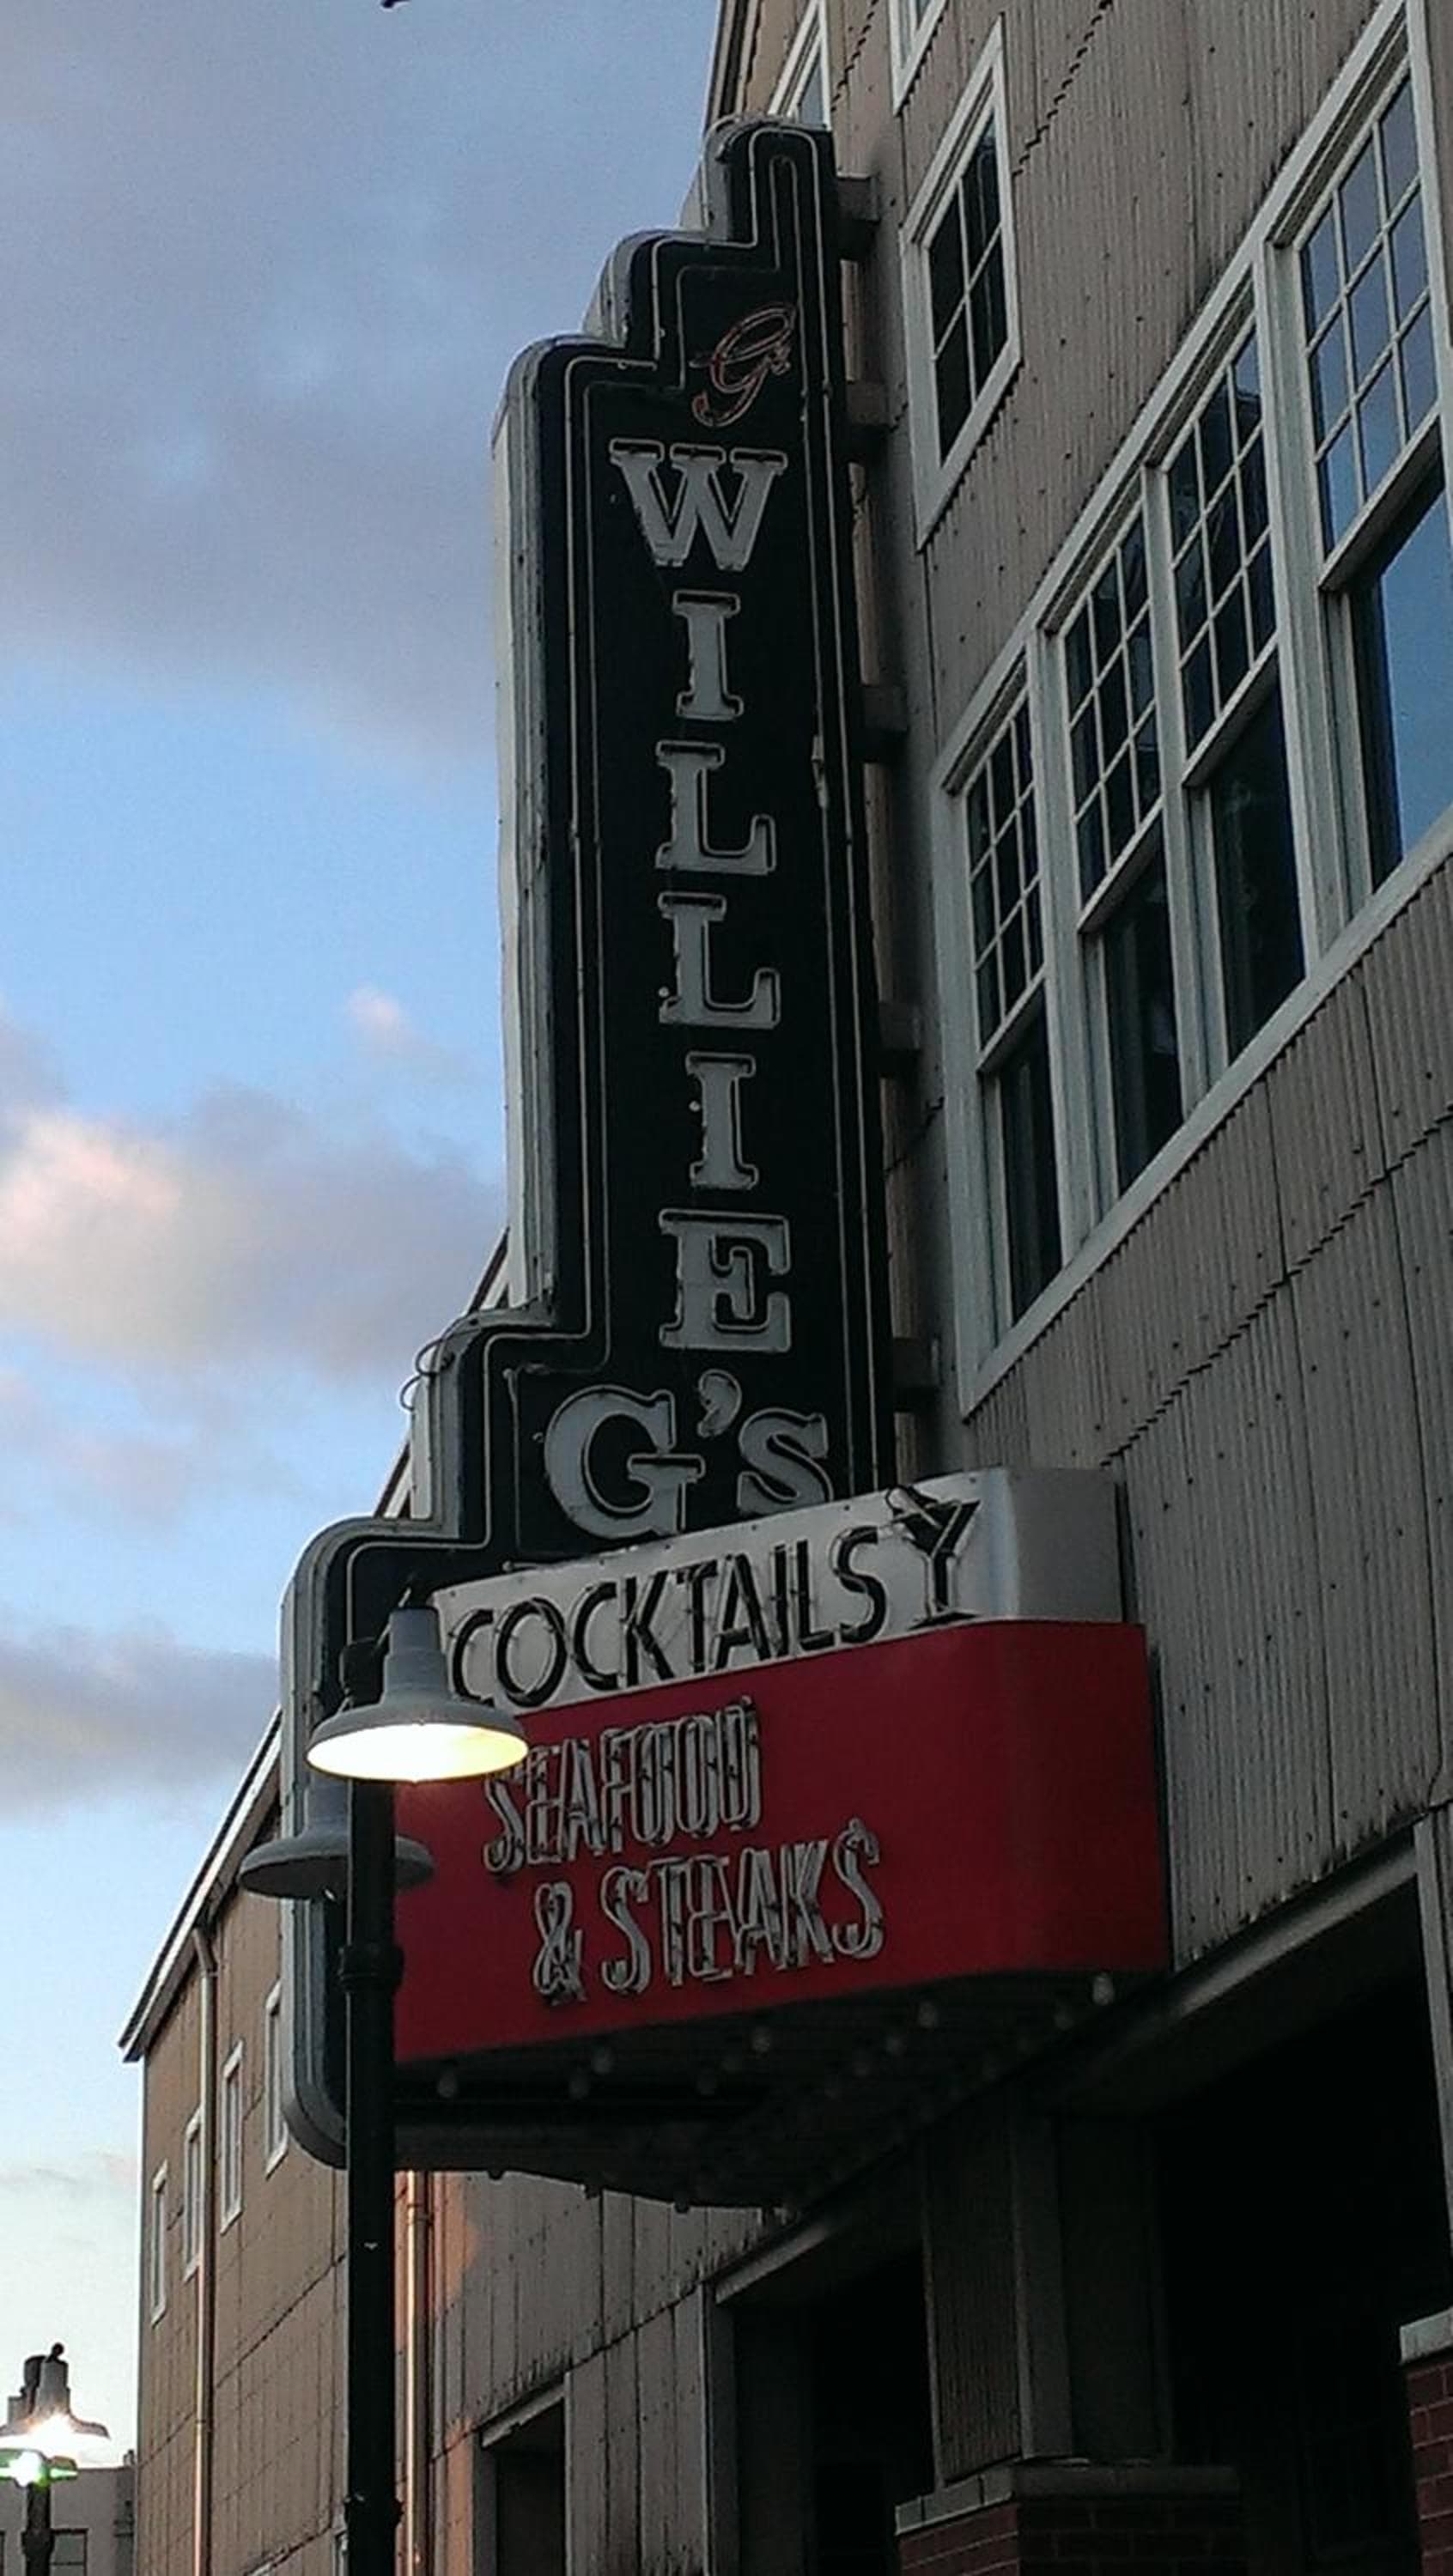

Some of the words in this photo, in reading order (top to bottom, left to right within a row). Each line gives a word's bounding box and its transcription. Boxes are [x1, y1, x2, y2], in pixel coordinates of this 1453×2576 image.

[607, 436, 793, 1354] WILLIE
[451, 1524, 885, 1708] COCKTAILS
[483, 1695, 763, 1874] SEAFOOD
[532, 1880, 587, 2007] &
[601, 1815, 886, 1996] STEAKS
